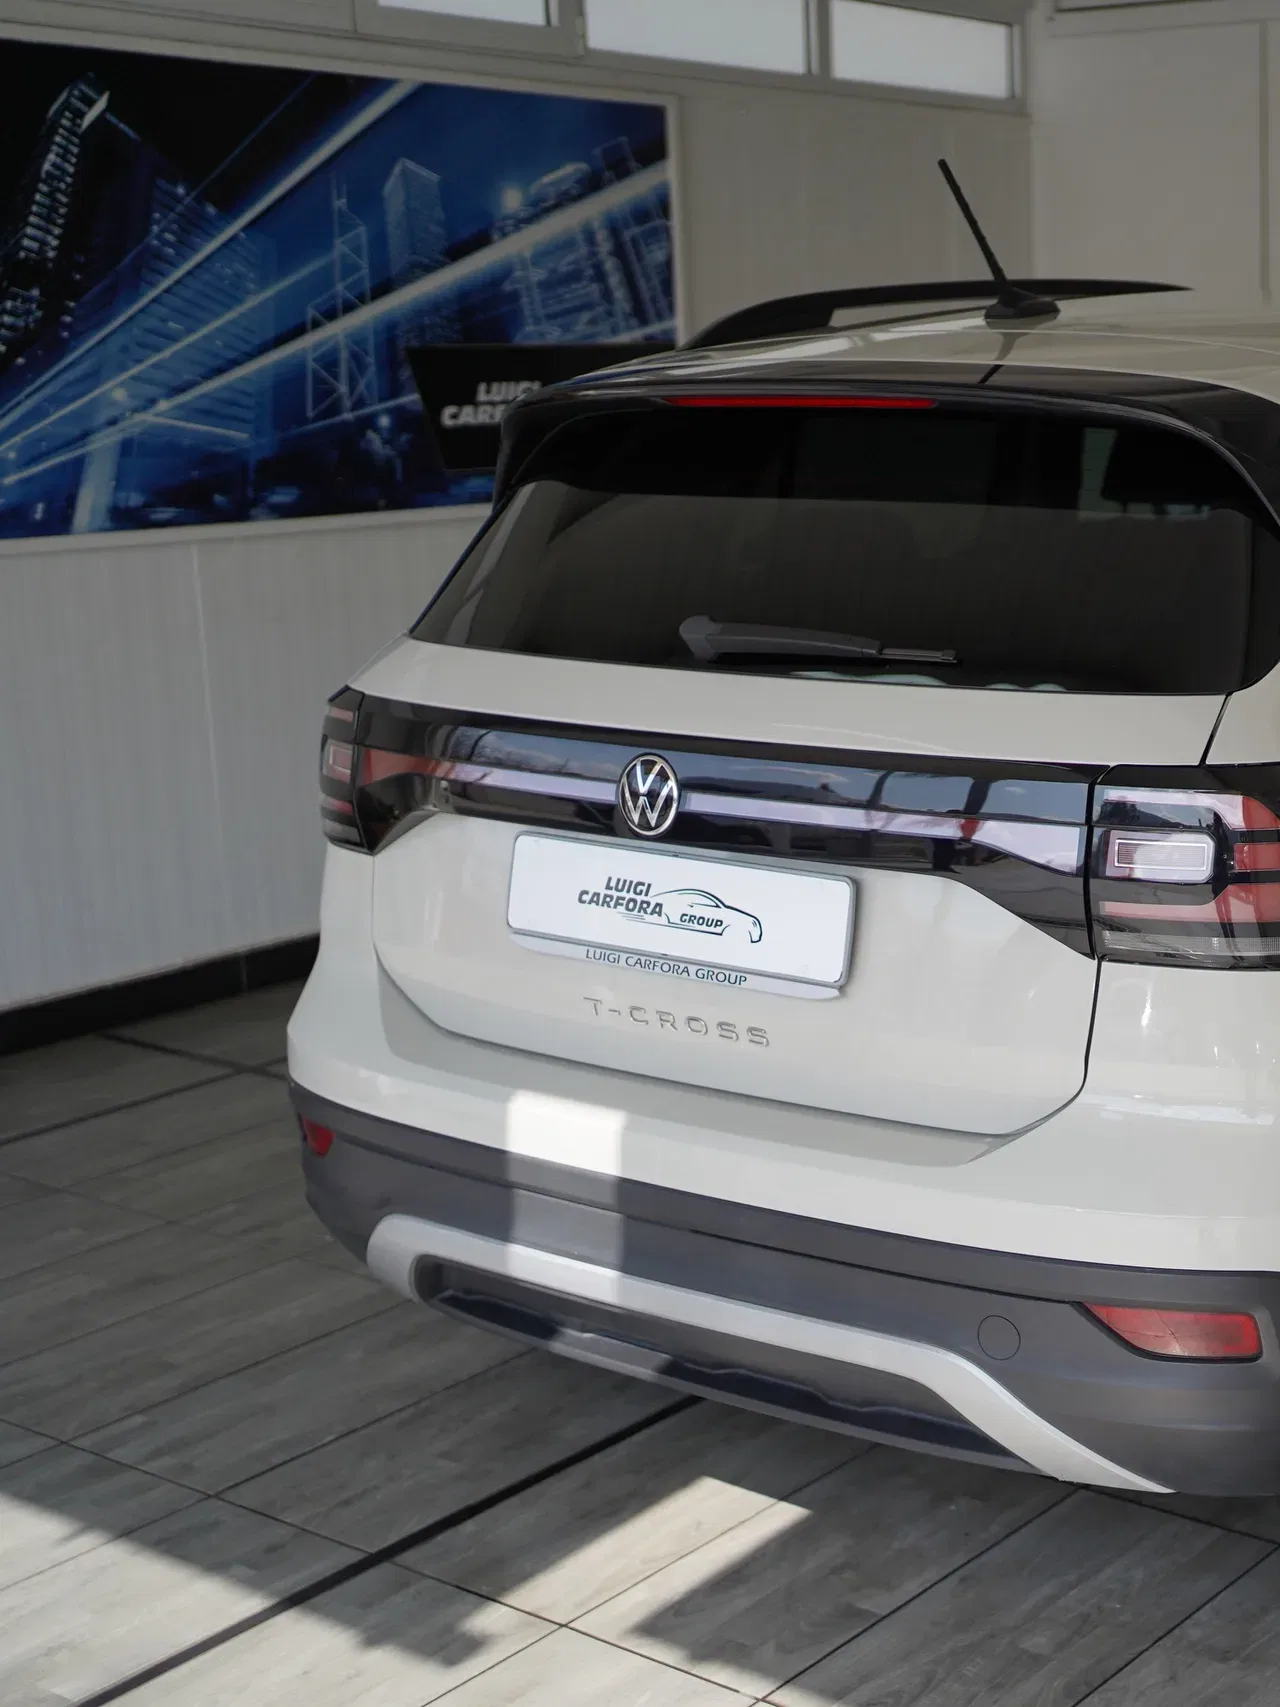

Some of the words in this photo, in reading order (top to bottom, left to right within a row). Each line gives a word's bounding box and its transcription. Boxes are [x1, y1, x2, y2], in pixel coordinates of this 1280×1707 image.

[604, 876, 652, 897] LUIGI
[577, 889, 664, 917] CARFORA
[679, 913, 724, 929] GROUP
[585, 949, 621, 964] LUIGI
[625, 956, 690, 977] CARFORA
[695, 968, 747, 986] GROUP
[583, 996, 770, 1047] T-CROSS
